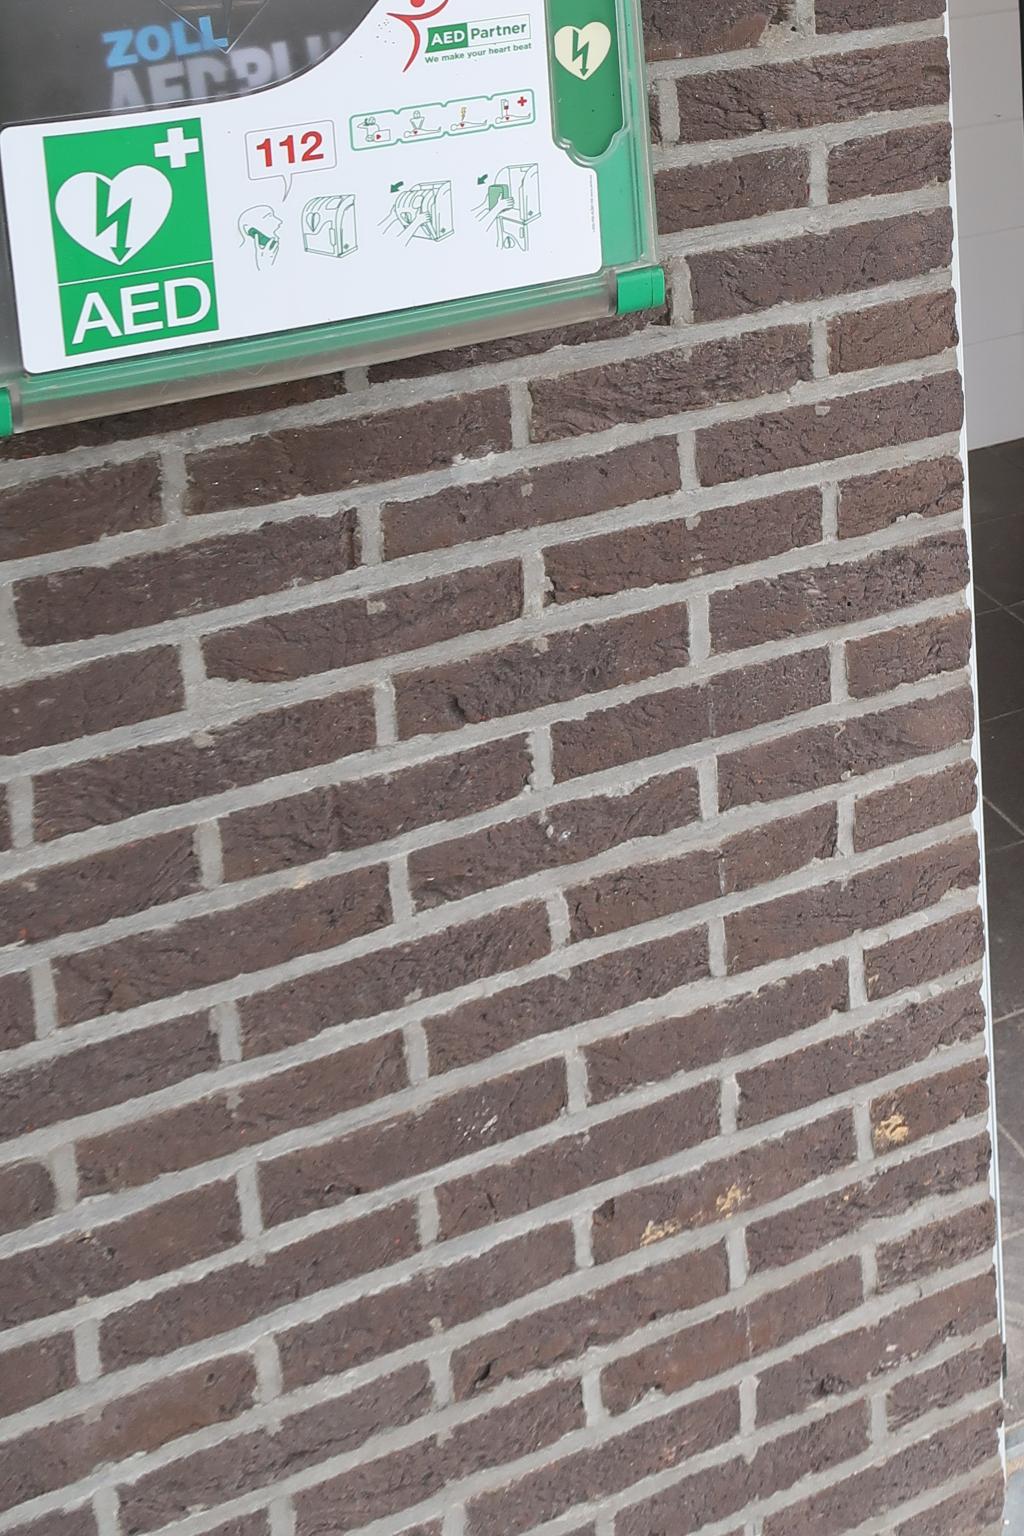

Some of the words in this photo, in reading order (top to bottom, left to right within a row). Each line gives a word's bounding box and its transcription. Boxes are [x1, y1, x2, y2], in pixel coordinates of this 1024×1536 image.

[102, 16, 229, 69] ZOLL
[431, 30, 465, 46] AED
[471, 24, 527, 40] Partner
[442, 53, 465, 61] make
[467, 49, 486, 59] your
[513, 42, 532, 51] beat
[256, 130, 324, 168] 112
[71, 276, 211, 345] AED
